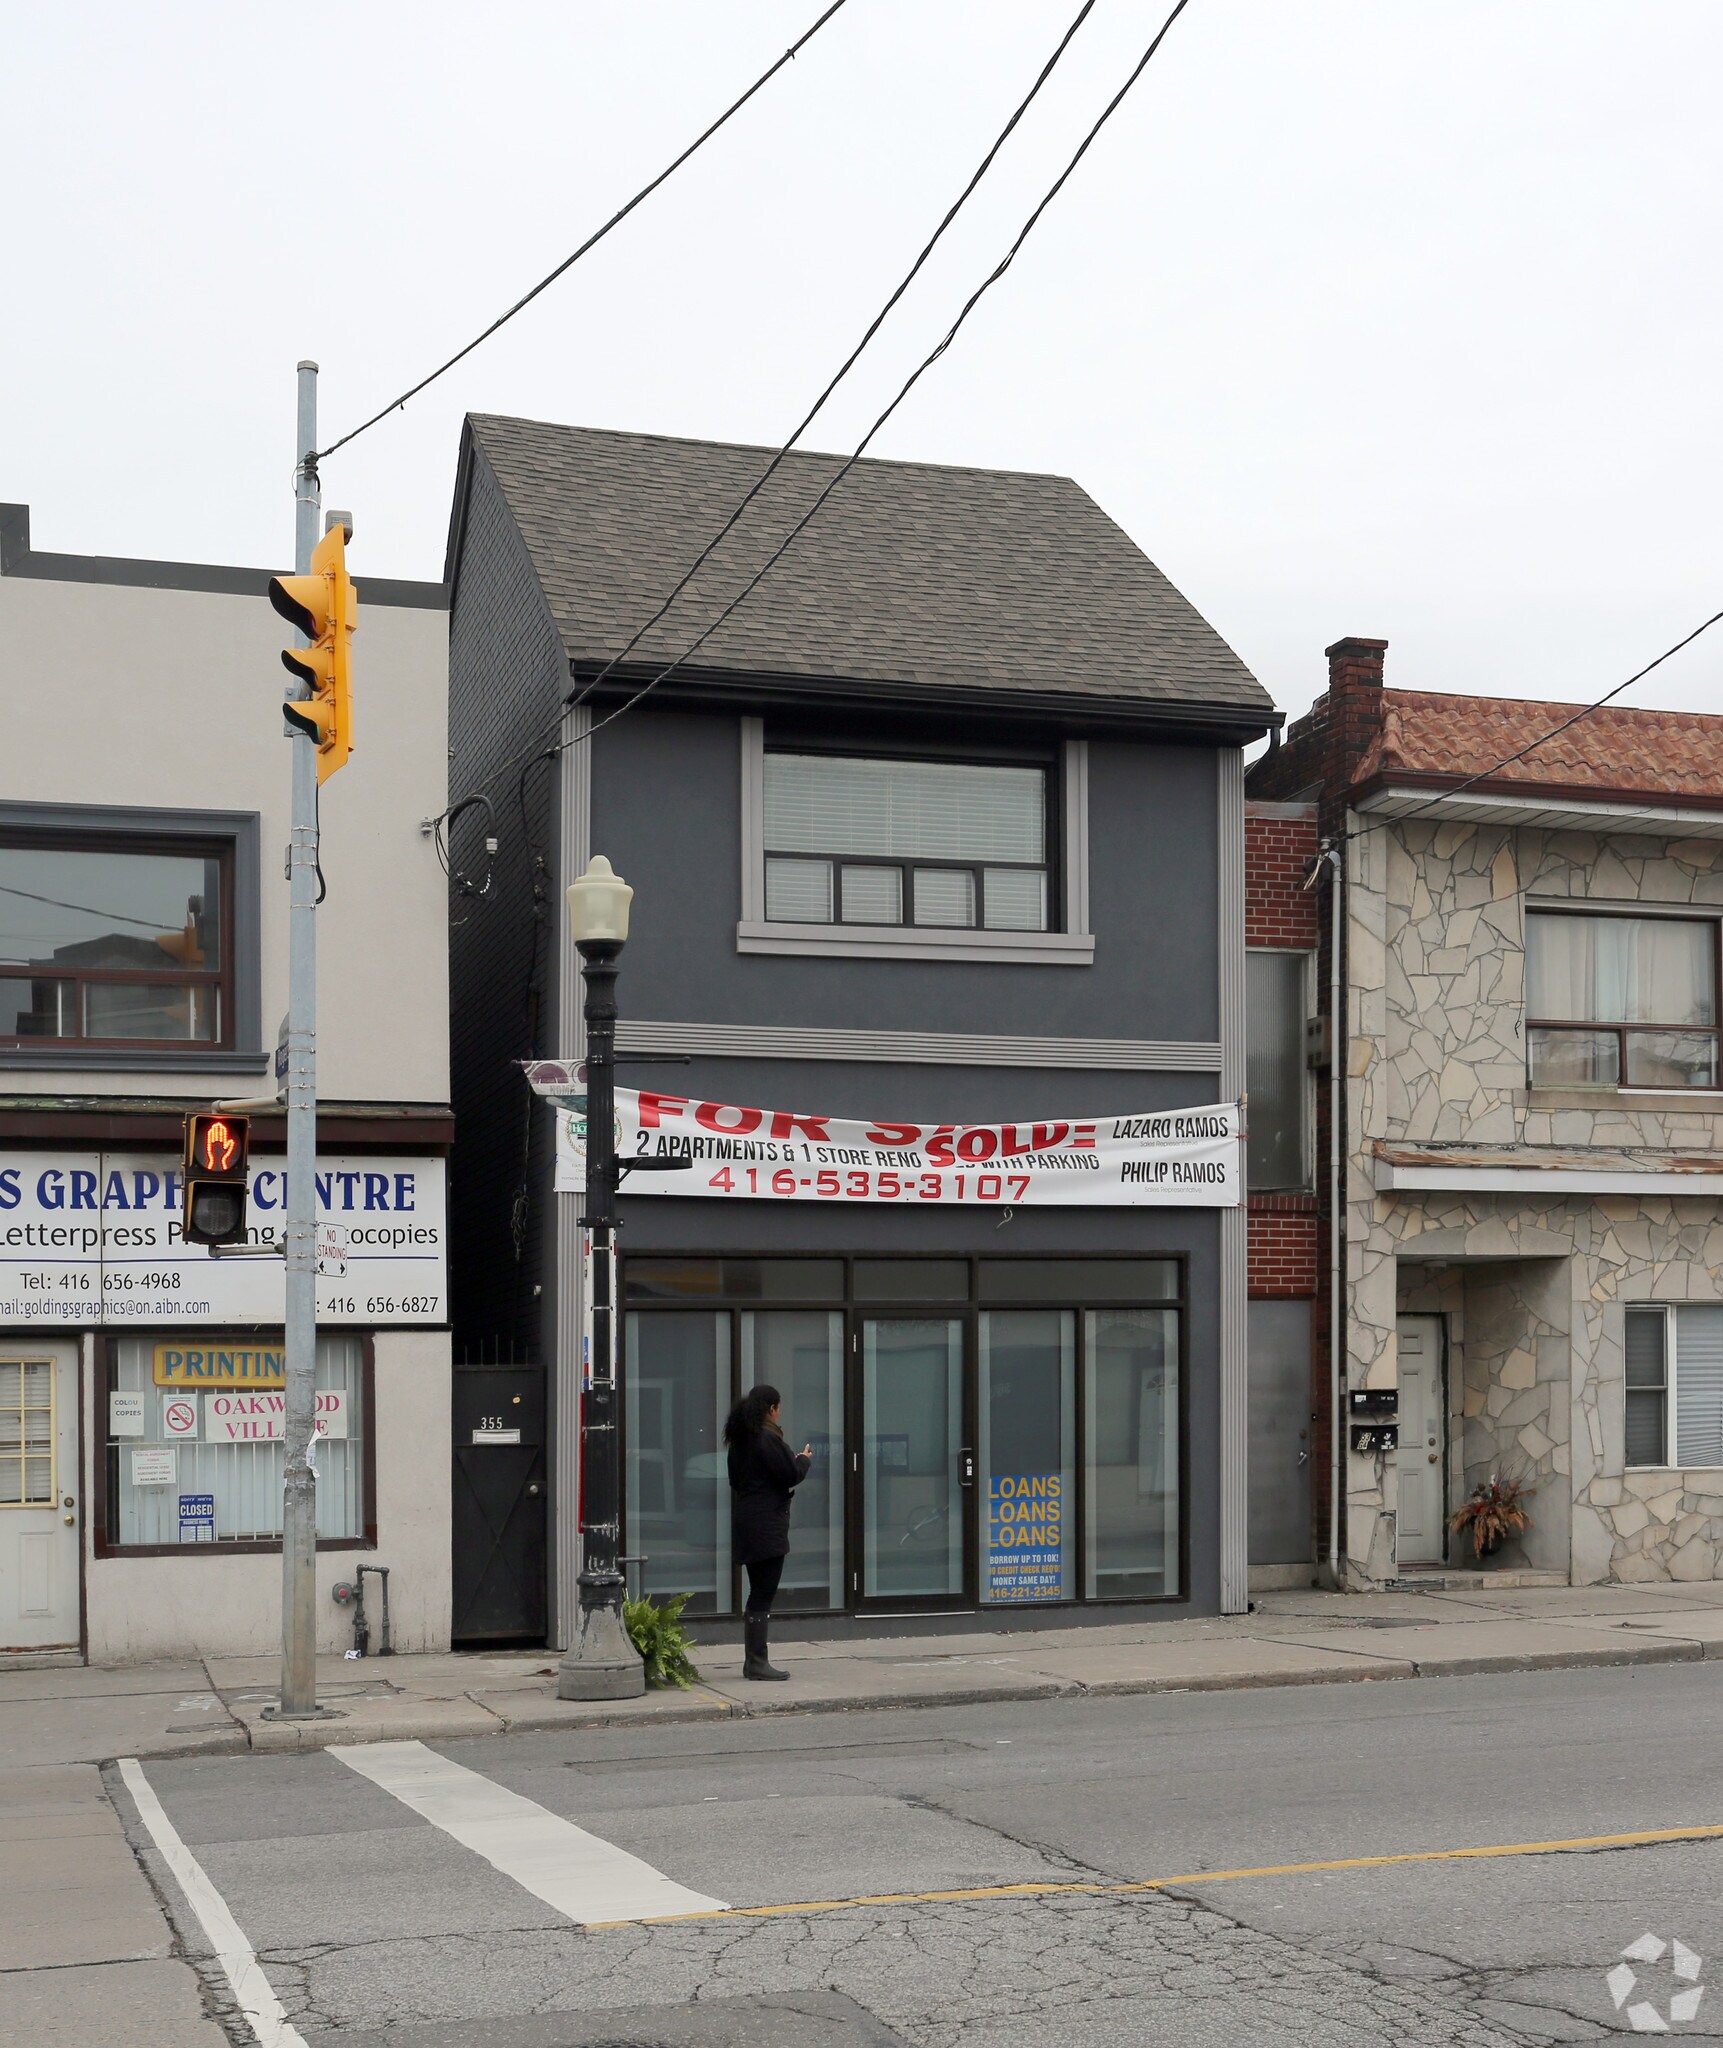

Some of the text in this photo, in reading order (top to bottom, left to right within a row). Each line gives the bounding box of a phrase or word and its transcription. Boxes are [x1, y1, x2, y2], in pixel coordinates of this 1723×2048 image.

[638, 1091, 831, 1141] FOR
[1113, 1117, 1228, 1139] LAZARO RAMOS
[636, 1130, 650, 1156] 2
[656, 1135, 778, 1162] APARTMENTS
[783, 1144, 794, 1162] &
[801, 1143, 811, 1162] 1
[816, 1147, 872, 1166] STORE
[1025, 1154, 1100, 1170] PARKING
[924, 1123, 1069, 1167] SOLD
[1121, 1162, 1225, 1183] PHILIP RAMOS
[36, 1169, 184, 1210] GRAPH
[253, 1171, 415, 1211] CNTRE
[708, 1167, 1031, 1200] 416-535-3107
[0, 1223, 156, 1252] etterpress
[346, 1224, 439, 1249] ocopies
[326, 1229, 336, 1242] NO
[317, 1244, 347, 1260] STANDING
[20, 1273, 181, 1290] Tel: 416 656-4968
[327, 1297, 355, 1313] 416
[366, 1297, 439, 1313] 656-6827
[163, 1351, 286, 1379] PRINTIN
[213, 1395, 340, 1416] OAKWD
[225, 1419, 329, 1439] VILLE
[480, 1416, 503, 1430] 355
[988, 1476, 1061, 1498] LOANS
[180, 1504, 213, 1516] CLOSED
[988, 1501, 1061, 1523] LOANS
[988, 1525, 1061, 1548] LOANS
[989, 1554, 1059, 1564] BORROW UP TO 10K!
[997, 1566, 1018, 1574] CREDIT
[1020, 1565, 1040, 1573] CHECK
[993, 1575, 1056, 1585] MONEY SAME DAY!
[988, 1586, 1060, 1598] 416-221-2345
